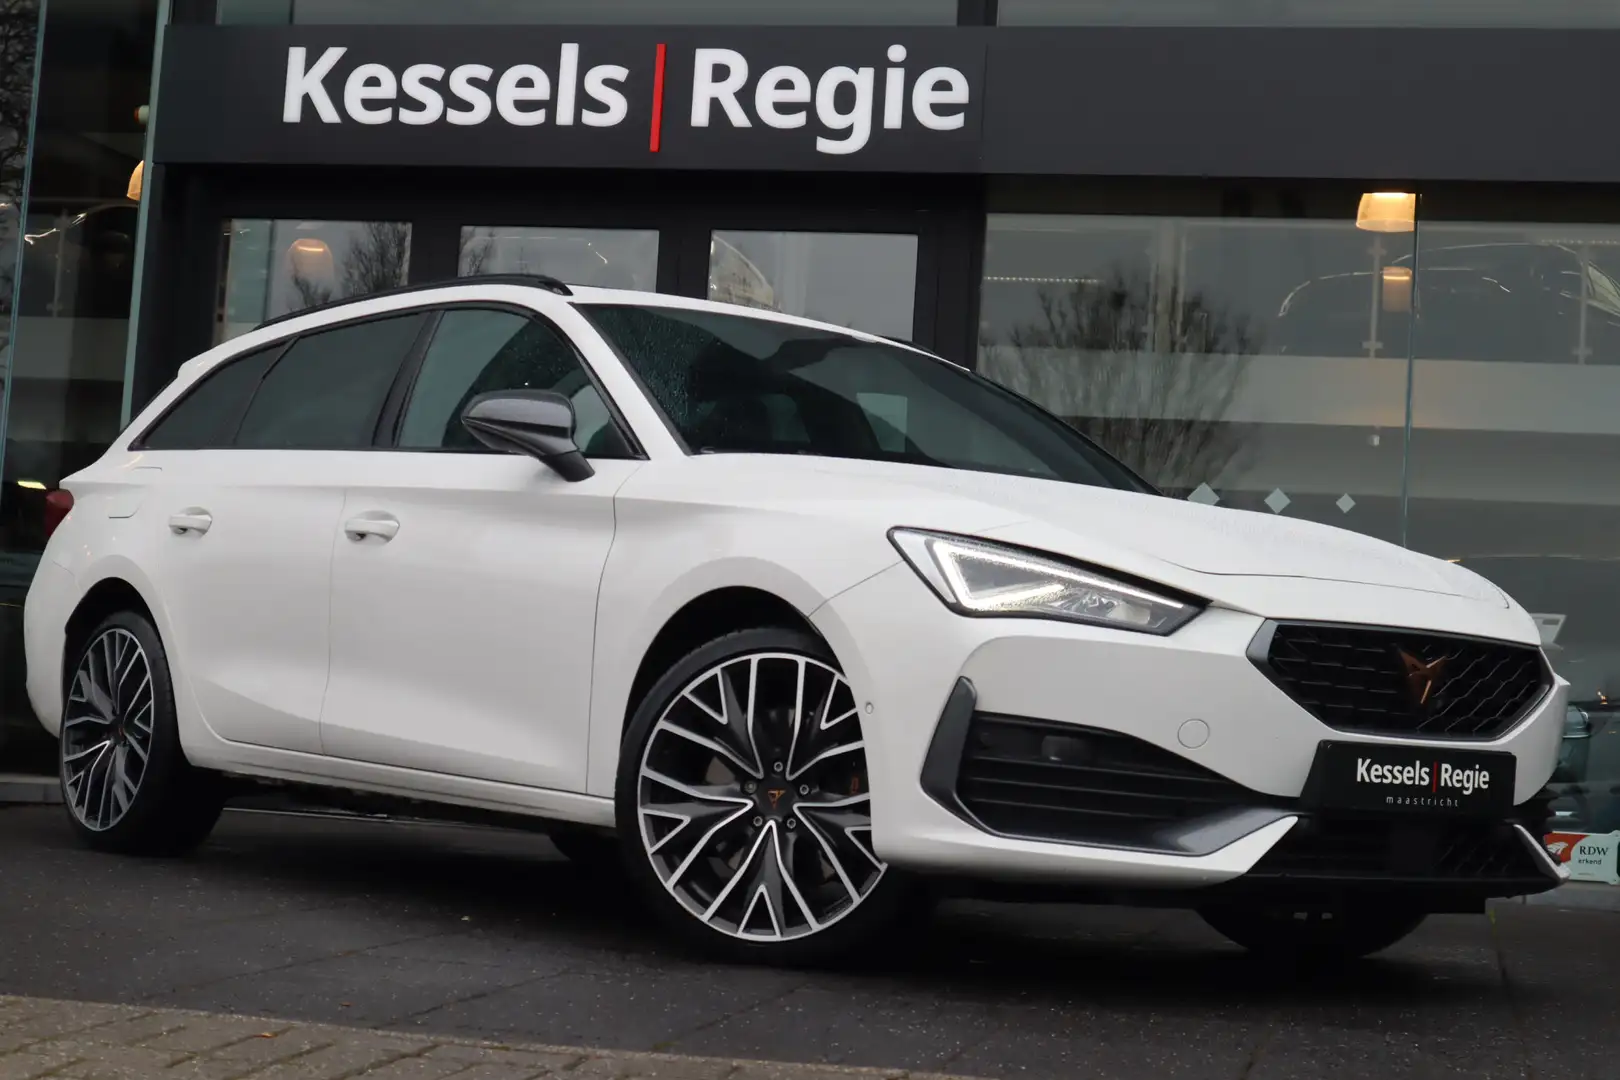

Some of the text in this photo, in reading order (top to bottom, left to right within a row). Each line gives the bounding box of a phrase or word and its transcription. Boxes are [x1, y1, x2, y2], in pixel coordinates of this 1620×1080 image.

[282, 43, 970, 155] Kessels Regie
[1356, 757, 1490, 795] Kessels Regie
[1386, 796, 1459, 807] maastricht
[1579, 845, 1609, 856] RDW
